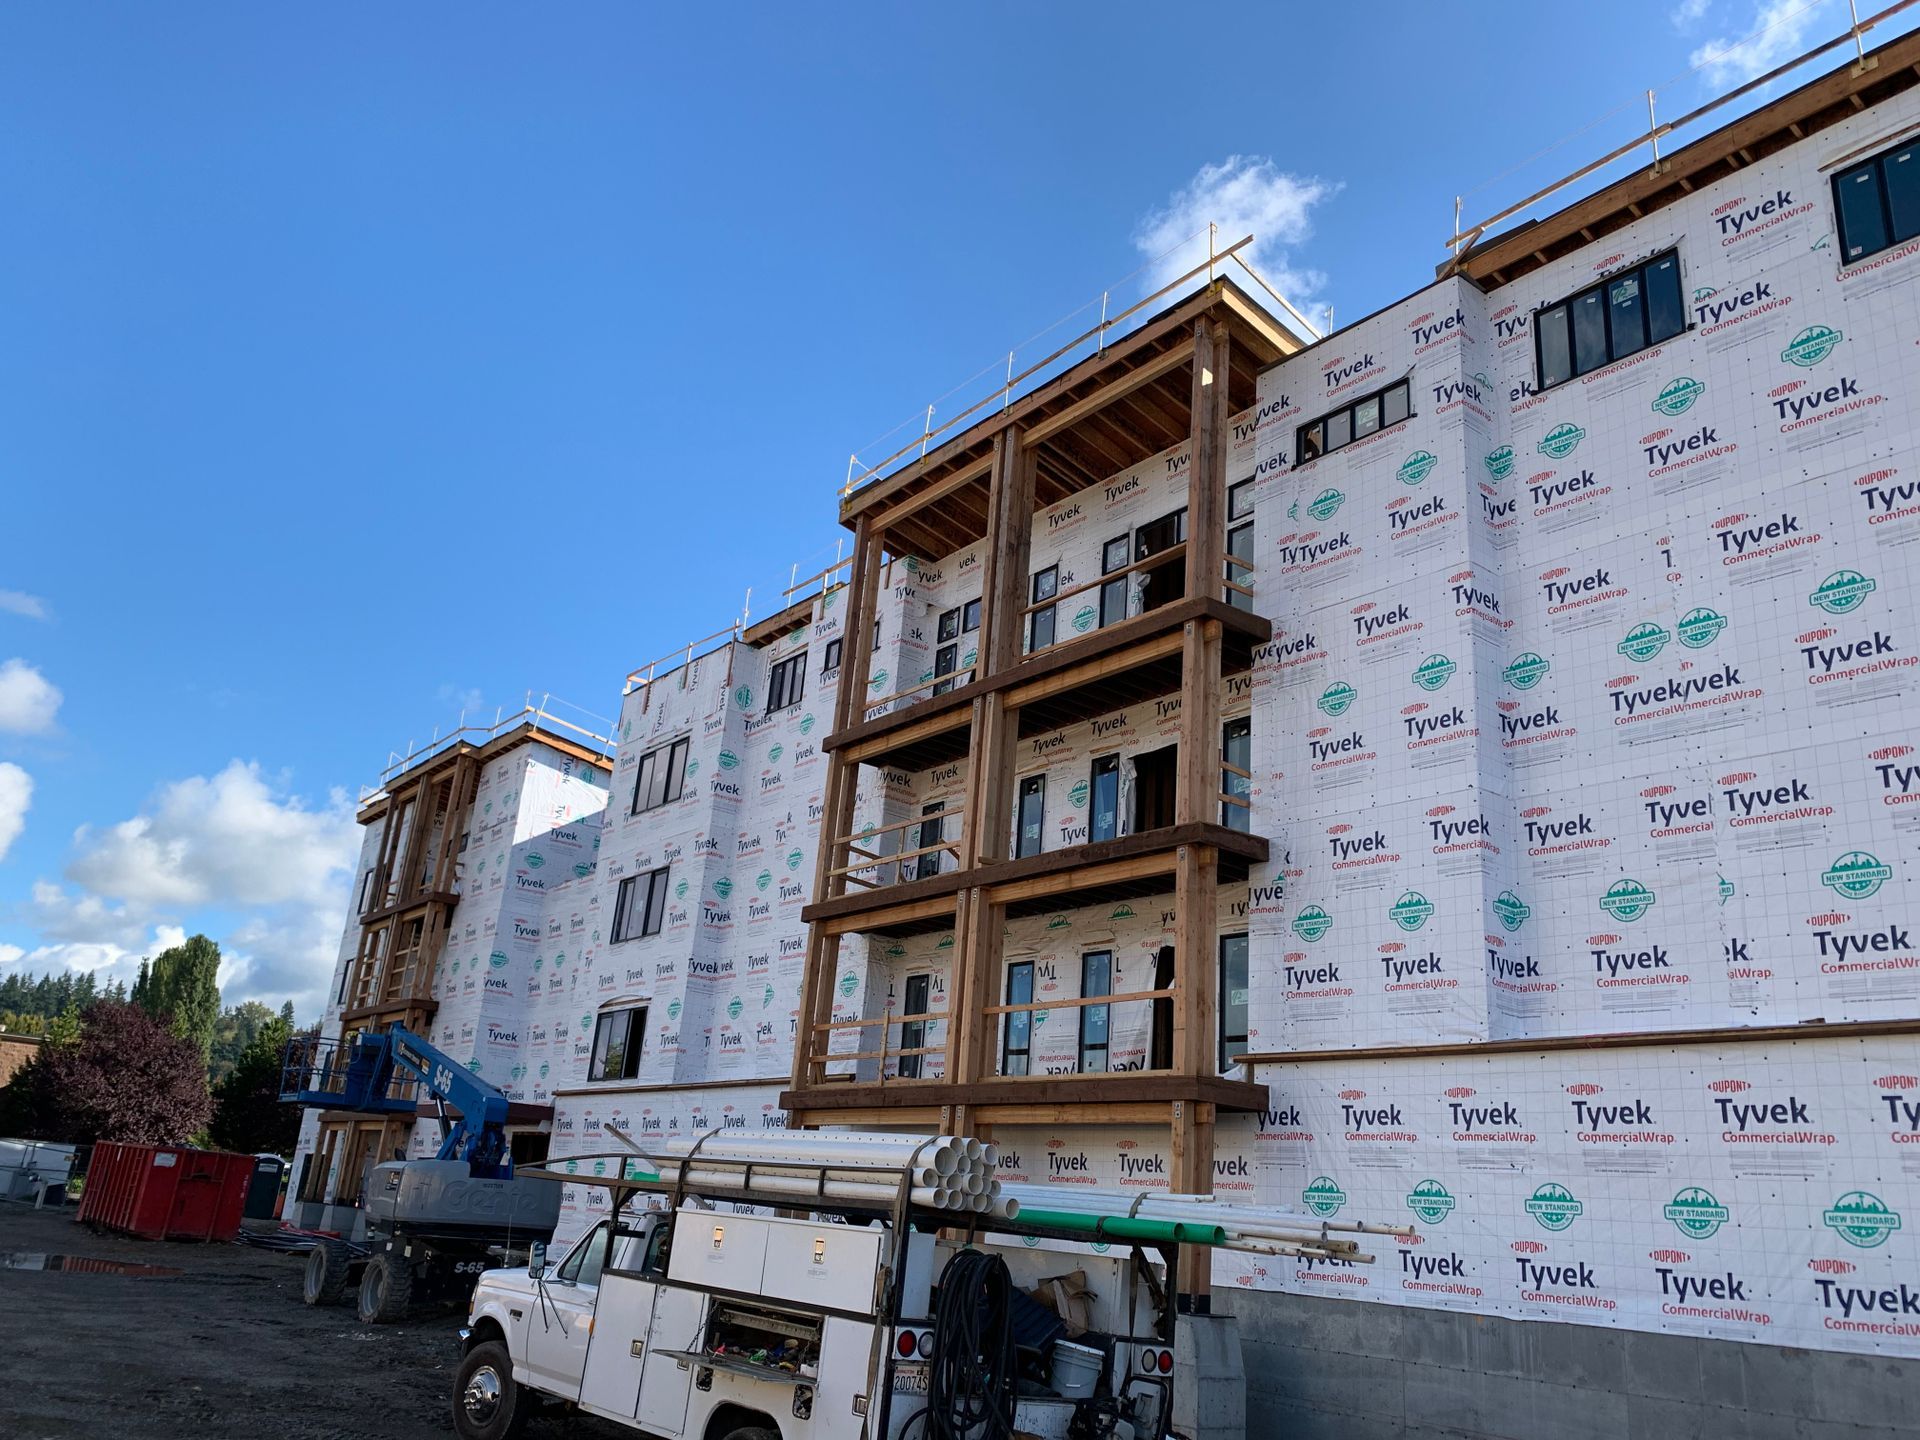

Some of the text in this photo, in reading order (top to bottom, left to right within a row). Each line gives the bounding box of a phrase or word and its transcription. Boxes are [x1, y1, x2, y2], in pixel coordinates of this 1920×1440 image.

[1715, 198, 1743, 216] DUPONT
[1715, 190, 1793, 234] Tyvek
[1721, 203, 1814, 247] CommercialWrap
[1597, 254, 1622, 270] DUPONT
[1695, 282, 1772, 324] Tyvek
[1700, 296, 1792, 337] CommercialWrap
[1412, 309, 1466, 345] Tyvek
[1785, 346, 1802, 359] NEW
[1324, 354, 1374, 387] Tyvek
[1582, 348, 1661, 384] CommercialWrap
[1327, 365, 1386, 397] CommercialWrap
[1771, 381, 1803, 398] DUPONT
[1433, 382, 1481, 403] Tyvek
[1773, 377, 1860, 420] Tyvek
[1655, 398, 1668, 408] NEW
[1780, 394, 1883, 434] CommercialWrap
[1642, 429, 1669, 445] DUPONT
[1644, 426, 1718, 465] Tyvek
[1648, 444, 1737, 478] CommercialWrap
[1528, 471, 1553, 484] DUPONT
[1859, 469, 1893, 486] DUPONT
[1104, 475, 1140, 501] Tyvek
[1530, 469, 1596, 505] Tyvek
[1388, 497, 1409, 510] DUPONT
[1534, 486, 1612, 517] CommercialWrap
[1048, 504, 1081, 528] Tyvek
[1388, 496, 1445, 529] Tyvek
[1391, 511, 1459, 541] CommercialWrap
[1715, 514, 1745, 529] DUPONT
[1717, 513, 1799, 553] Tyvek
[1722, 532, 1822, 566] CommercialWrap
[1543, 568, 1567, 581] DUPONT
[1544, 569, 1611, 604] Tyvek
[1452, 584, 1500, 614] Tyvek
[1547, 587, 1628, 615] CommercialWrap
[1813, 590, 1831, 603] NEW
[815, 617, 837, 636] Tyvek
[1354, 604, 1409, 636] Tyvek
[1356, 622, 1423, 647] CommercialWrap
[1799, 629, 1833, 644] DUPONT
[1621, 641, 1636, 652] NEW
[1801, 632, 1894, 672] Tyvek
[1809, 655, 1918, 685] CommercialWrap
[1608, 676, 1636, 688] DUPONT
[1404, 703, 1425, 715] DUPONT
[704, 717, 723, 733] Tyvek
[1091, 713, 1127, 737] Tyvek
[1404, 706, 1464, 739] Tyvek
[1499, 706, 1559, 739] Tyvek
[1032, 732, 1065, 754] Tyvek
[1309, 732, 1363, 761] Tyvek
[1407, 728, 1480, 750] CommercialWrap
[1311, 752, 1376, 771] CommercialWrap
[1873, 746, 1908, 763] DUPONT
[761, 772, 782, 788] Tyvek
[931, 764, 958, 783] Tyvek
[1721, 773, 1752, 786] DUPONT
[710, 780, 739, 796] Tyvek
[1644, 786, 1672, 798] DUPONT
[1723, 779, 1810, 816] Tyvek
[1429, 806, 1452, 817] DUPONT
[1523, 807, 1549, 818] DUPONT
[1729, 806, 1833, 828] CommercialWrap
[551, 828, 577, 842] Tyvek
[1430, 814, 1490, 844] Tyvek
[1524, 814, 1593, 846] Tyvek
[1330, 831, 1386, 860] Tyvek
[1528, 838, 1610, 857] CommercialWrap
[1332, 853, 1400, 870] CommercialWrap
[516, 875, 545, 889] Tyvek
[1826, 869, 1888, 883] NEW STANDARD
[779, 883, 802, 900] Tyvek
[749, 902, 770, 917] Tyvek
[1603, 899, 1618, 907] NEW
[669, 909, 688, 924] Tyvek
[1811, 914, 1846, 926] DUPONT
[779, 937, 803, 954] Tyvek
[1380, 943, 1403, 953] DUPONT
[1590, 934, 1619, 945] DUPONT
[1813, 925, 1911, 962] Tyvek
[656, 961, 675, 976] Tyvek
[748, 953, 769, 968] Tyvek
[1381, 952, 1442, 982] Tyvek
[1488, 949, 1540, 979] Tyvek
[1591, 945, 1669, 977] Tyvek
[1285, 963, 1339, 990] Tyvek
[1385, 978, 1458, 992] CommercialWrap
[1597, 974, 1690, 988] CommercialWrap
[1286, 987, 1353, 1000] CommercialWrap
[488, 1028, 517, 1041] Tyvek
[660, 1032, 679, 1048] Tyvek
[720, 1033, 742, 1048] Tyvek
[434, 1064, 454, 1094] S-65
[1713, 1080, 1747, 1093] DUPONT
[1879, 1076, 1919, 1090] DUPONT
[1341, 1089, 1364, 1100] DUPONT
[1448, 1087, 1474, 1098] DUPONT
[1570, 1084, 1600, 1096] DUPONT
[724, 1114, 746, 1129] Tyvek
[762, 1114, 787, 1129] Tyvek
[1341, 1104, 1402, 1132] Tyvek
[1449, 1102, 1518, 1131] Tyvek
[1572, 1100, 1653, 1131] Tyvek
[1715, 1097, 1810, 1131] Tyvek
[556, 1118, 573, 1130] Tyvek
[642, 1117, 661, 1131] Tyvek
[1345, 1131, 1418, 1143] CommercialWrap
[1452, 1131, 1536, 1143] CommercialWrap
[1577, 1131, 1674, 1145] CommercialWrap
[1722, 1131, 1836, 1144] CommercialWrap
[1048, 1152, 1088, 1175] Tyvek
[1119, 1153, 1163, 1177] Tyvek
[1410, 1198, 1422, 1206] NEW
[1528, 1203, 1579, 1213] NEW STANDARD
[1668, 1208, 1725, 1219] NEW STANDARD
[1828, 1214, 1896, 1226] NEW STANDARD
[1515, 1241, 1543, 1253] DUPONT
[1399, 1249, 1465, 1280] Tyvek
[1654, 1250, 1686, 1263] DUPONT
[454, 1262, 485, 1274] S-65
[1516, 1258, 1596, 1291] Tyvek
[1813, 1260, 1851, 1274] DUPONT
[1296, 1270, 1368, 1285] CommercialWrap
[1655, 1268, 1746, 1304] Tyvek
[1403, 1279, 1482, 1297] CommercialWrap
[1521, 1290, 1616, 1310] CommercialWrap
[1814, 1279, 1920, 1318] Tyvek
[1662, 1303, 1771, 1326] CommercialWrap
[895, 1375, 928, 1391] 20074S
